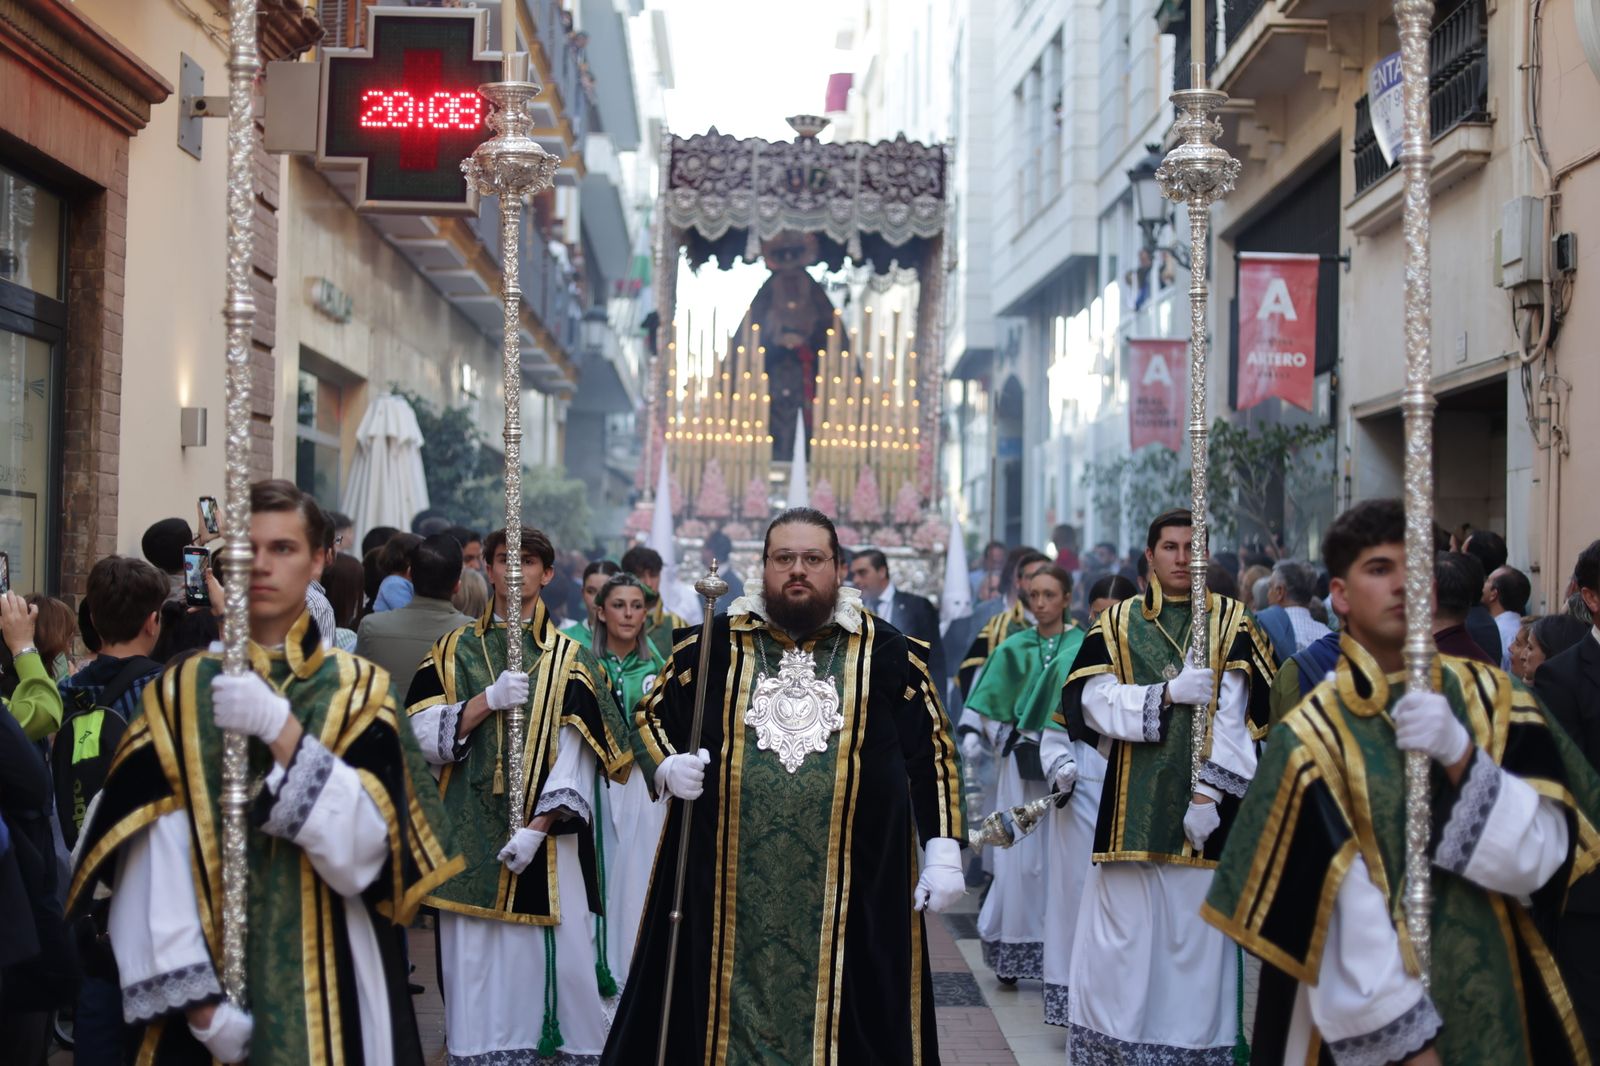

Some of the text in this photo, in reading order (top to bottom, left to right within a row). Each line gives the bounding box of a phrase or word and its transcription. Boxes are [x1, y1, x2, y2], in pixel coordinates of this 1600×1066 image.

[1371, 56, 1404, 98] ENTA
[361, 90, 481, 129] 20:08
[1256, 278, 1298, 321] A
[1142, 353, 1174, 386] A
[1246, 351, 1307, 368] ARTERO
